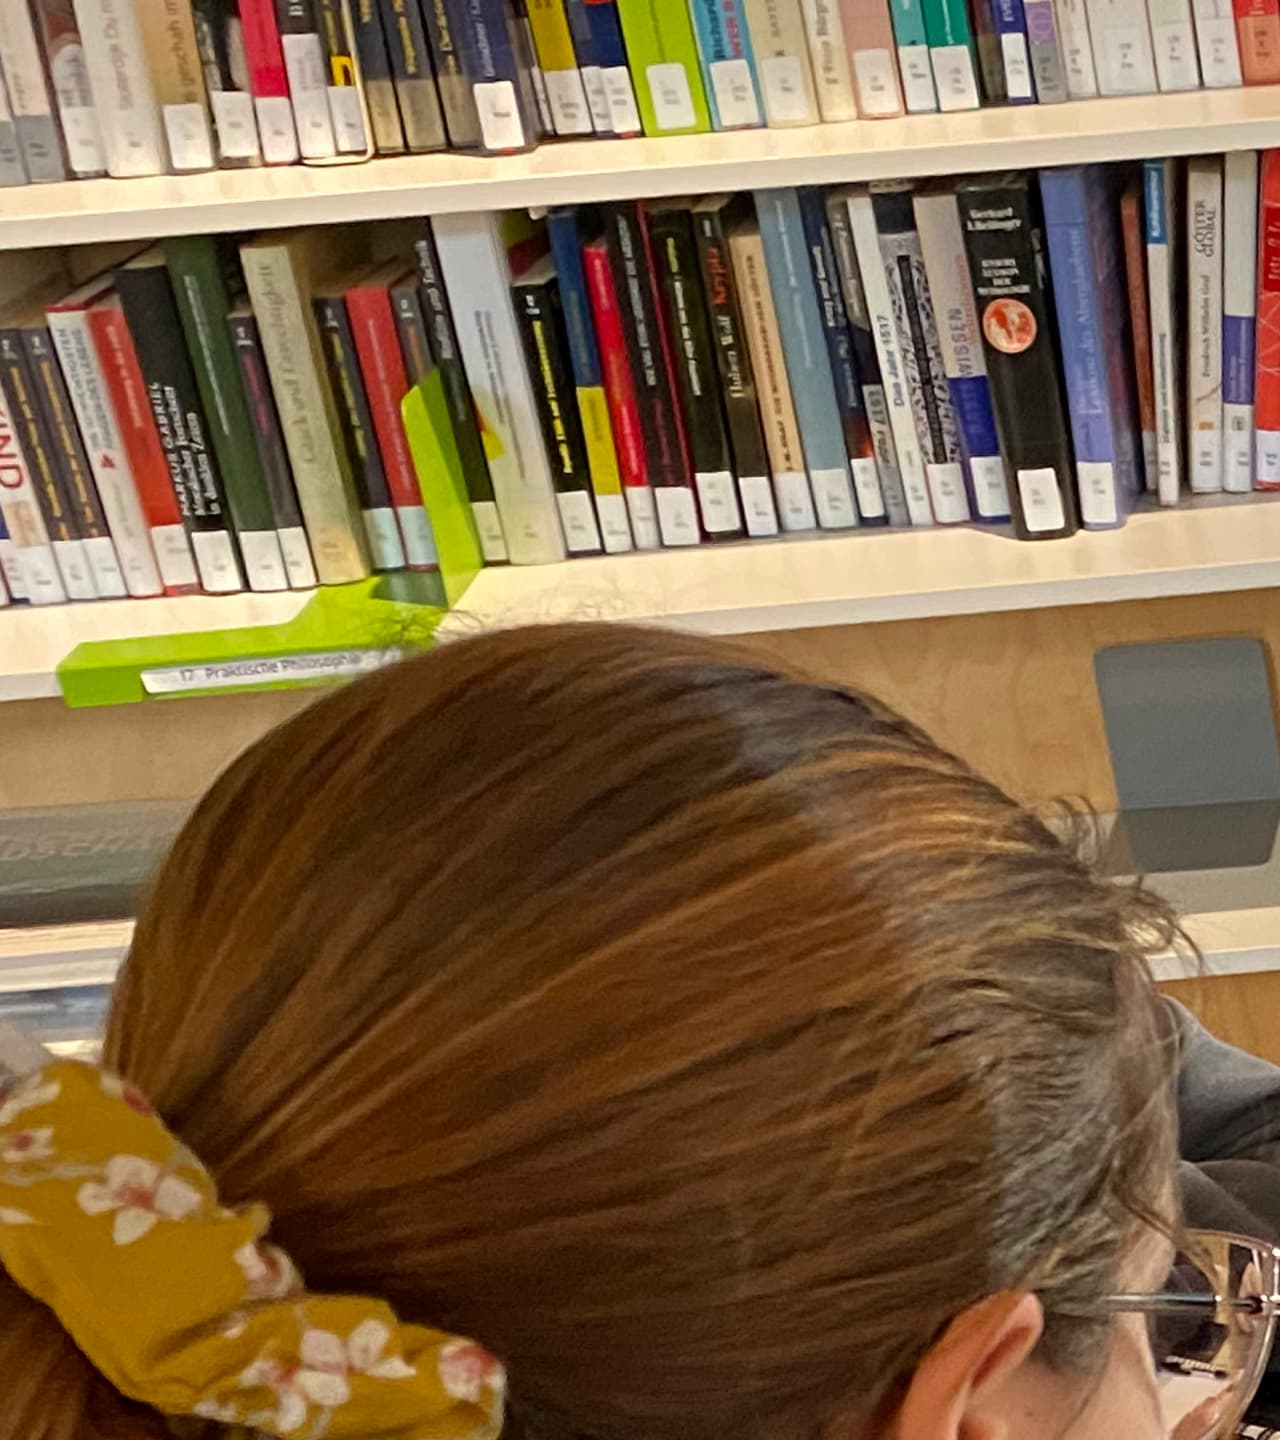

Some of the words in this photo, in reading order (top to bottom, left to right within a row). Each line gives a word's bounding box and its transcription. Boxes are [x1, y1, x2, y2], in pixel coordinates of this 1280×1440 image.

[1191, 199, 1206, 254] GÖTTER
[1202, 209, 1216, 258] GLOBAL
[414, 239, 436, 284] Technik
[705, 246, 727, 305] Krypta
[257, 264, 294, 374] Gerechtigkeit
[426, 287, 443, 312] und
[716, 314, 734, 345] Wolf
[876, 313, 892, 346] 1517
[947, 307, 973, 377] WISSEN
[884, 349, 898, 379] Jahr
[283, 379, 305, 411] und
[890, 382, 905, 407] Das
[147, 381, 174, 449] GABRIEL
[165, 453, 191, 516] MARKUS
[204, 661, 280, 680] Praktische
